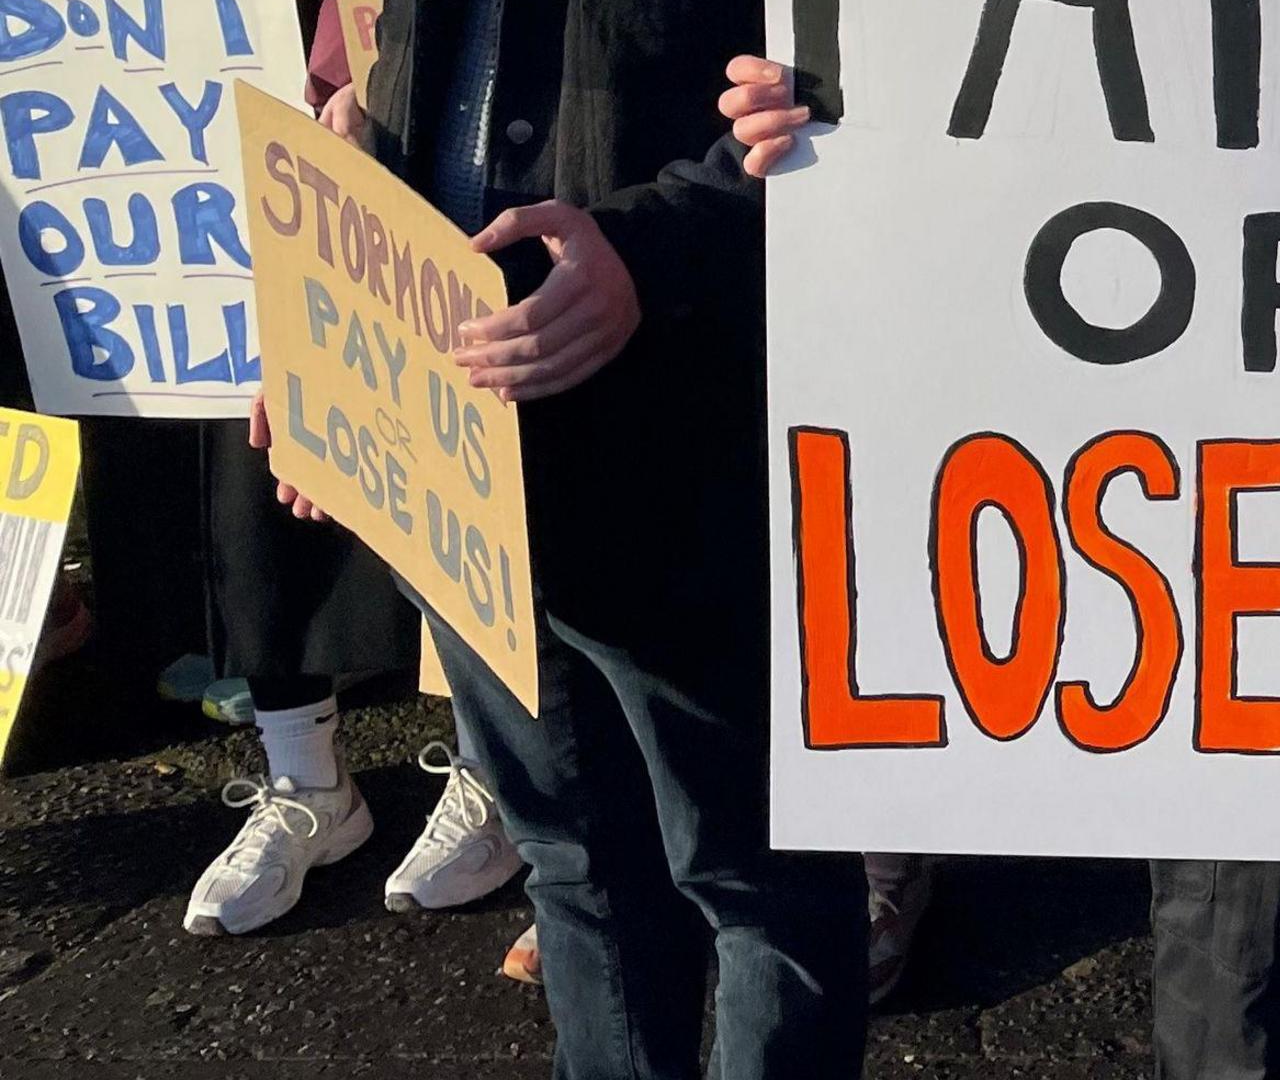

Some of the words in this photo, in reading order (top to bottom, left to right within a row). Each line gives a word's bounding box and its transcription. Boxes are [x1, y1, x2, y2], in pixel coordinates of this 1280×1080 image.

[0, 80, 223, 180] PAY
[18, 182, 252, 277] OUR
[53, 286, 262, 385] BILL
[304, 275, 407, 408] PAY
[428, 369, 492, 499] US
[375, 407, 418, 464] OR
[286, 370, 413, 536] LOSE
[426, 488, 517, 652] US!
